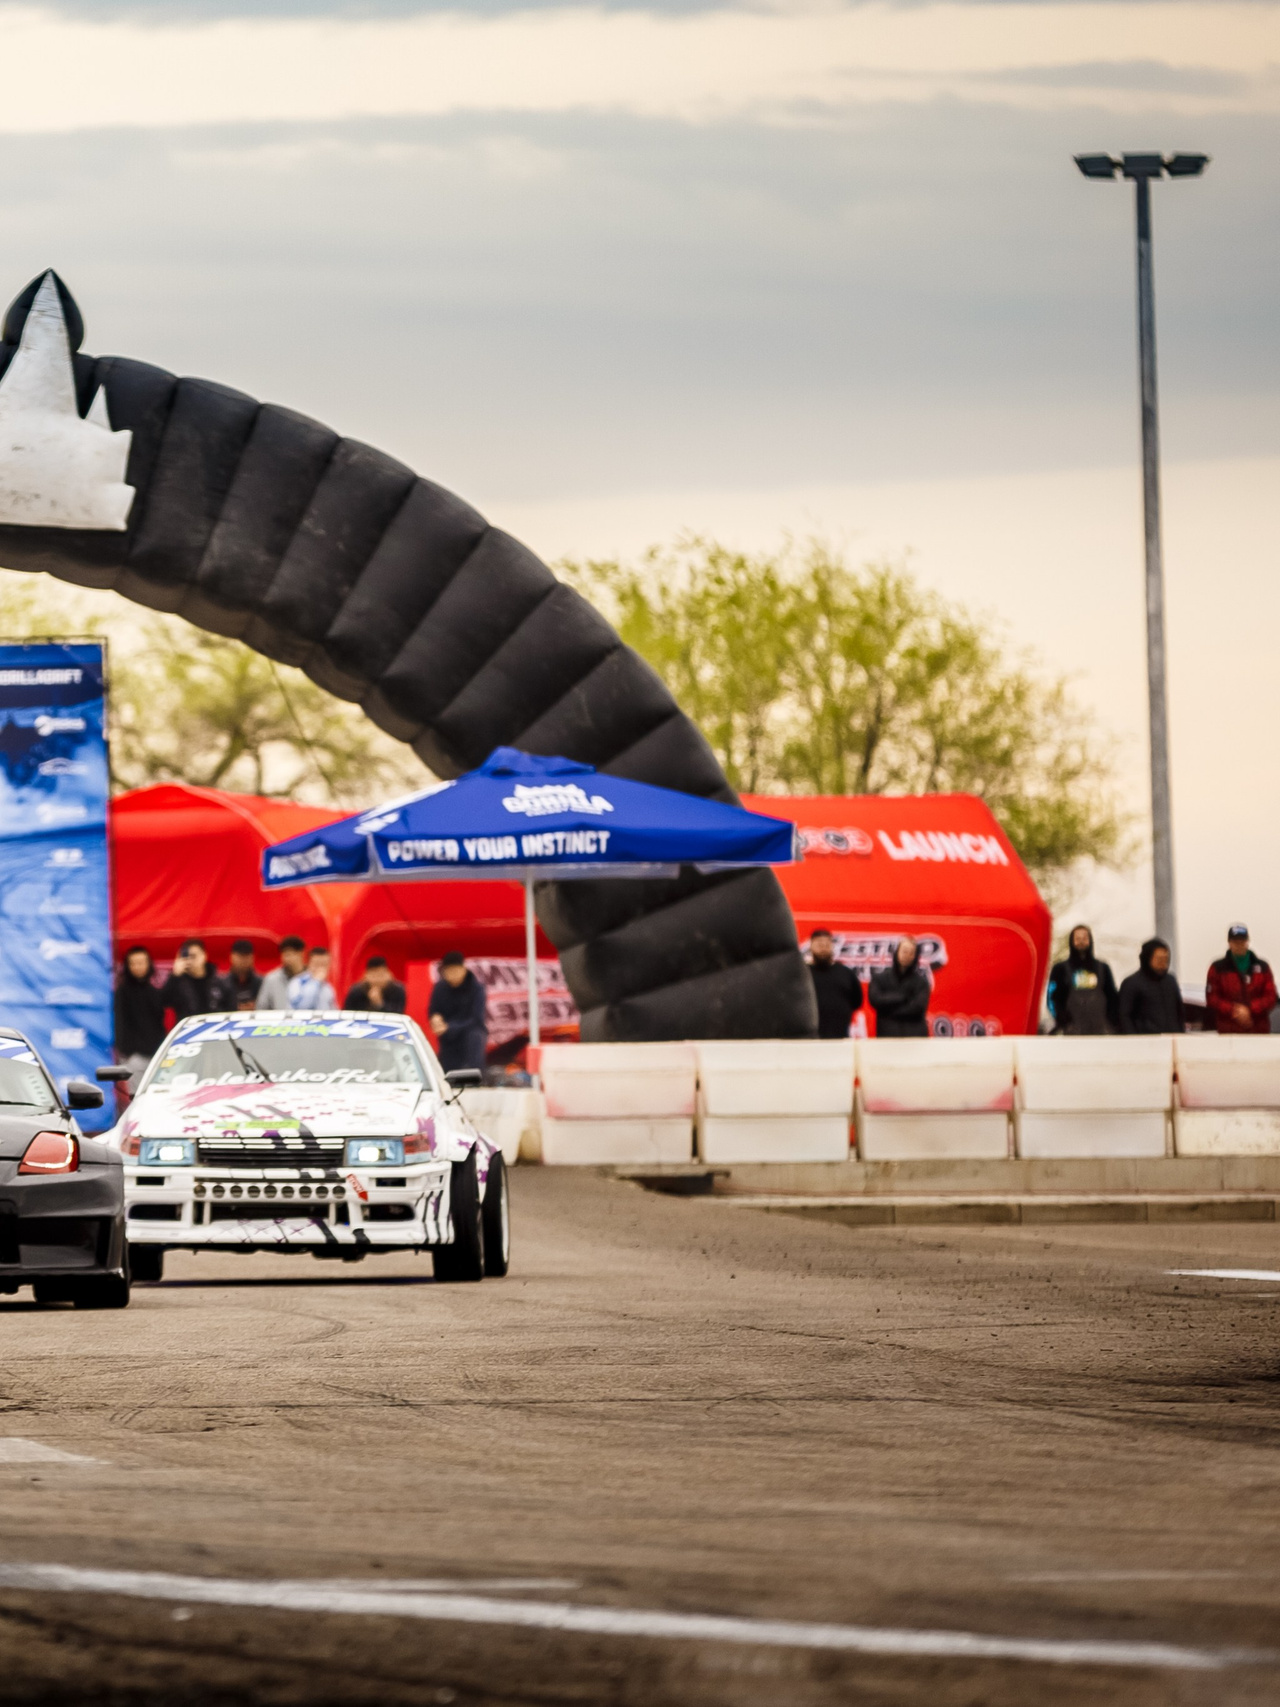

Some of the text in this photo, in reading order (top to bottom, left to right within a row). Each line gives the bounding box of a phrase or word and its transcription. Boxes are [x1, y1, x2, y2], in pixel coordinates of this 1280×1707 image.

[387, 830, 610, 862] POWER YOUR INSTINCT
[877, 829, 1009, 867] LAUNCH
[166, 1043, 202, 1060] 96
